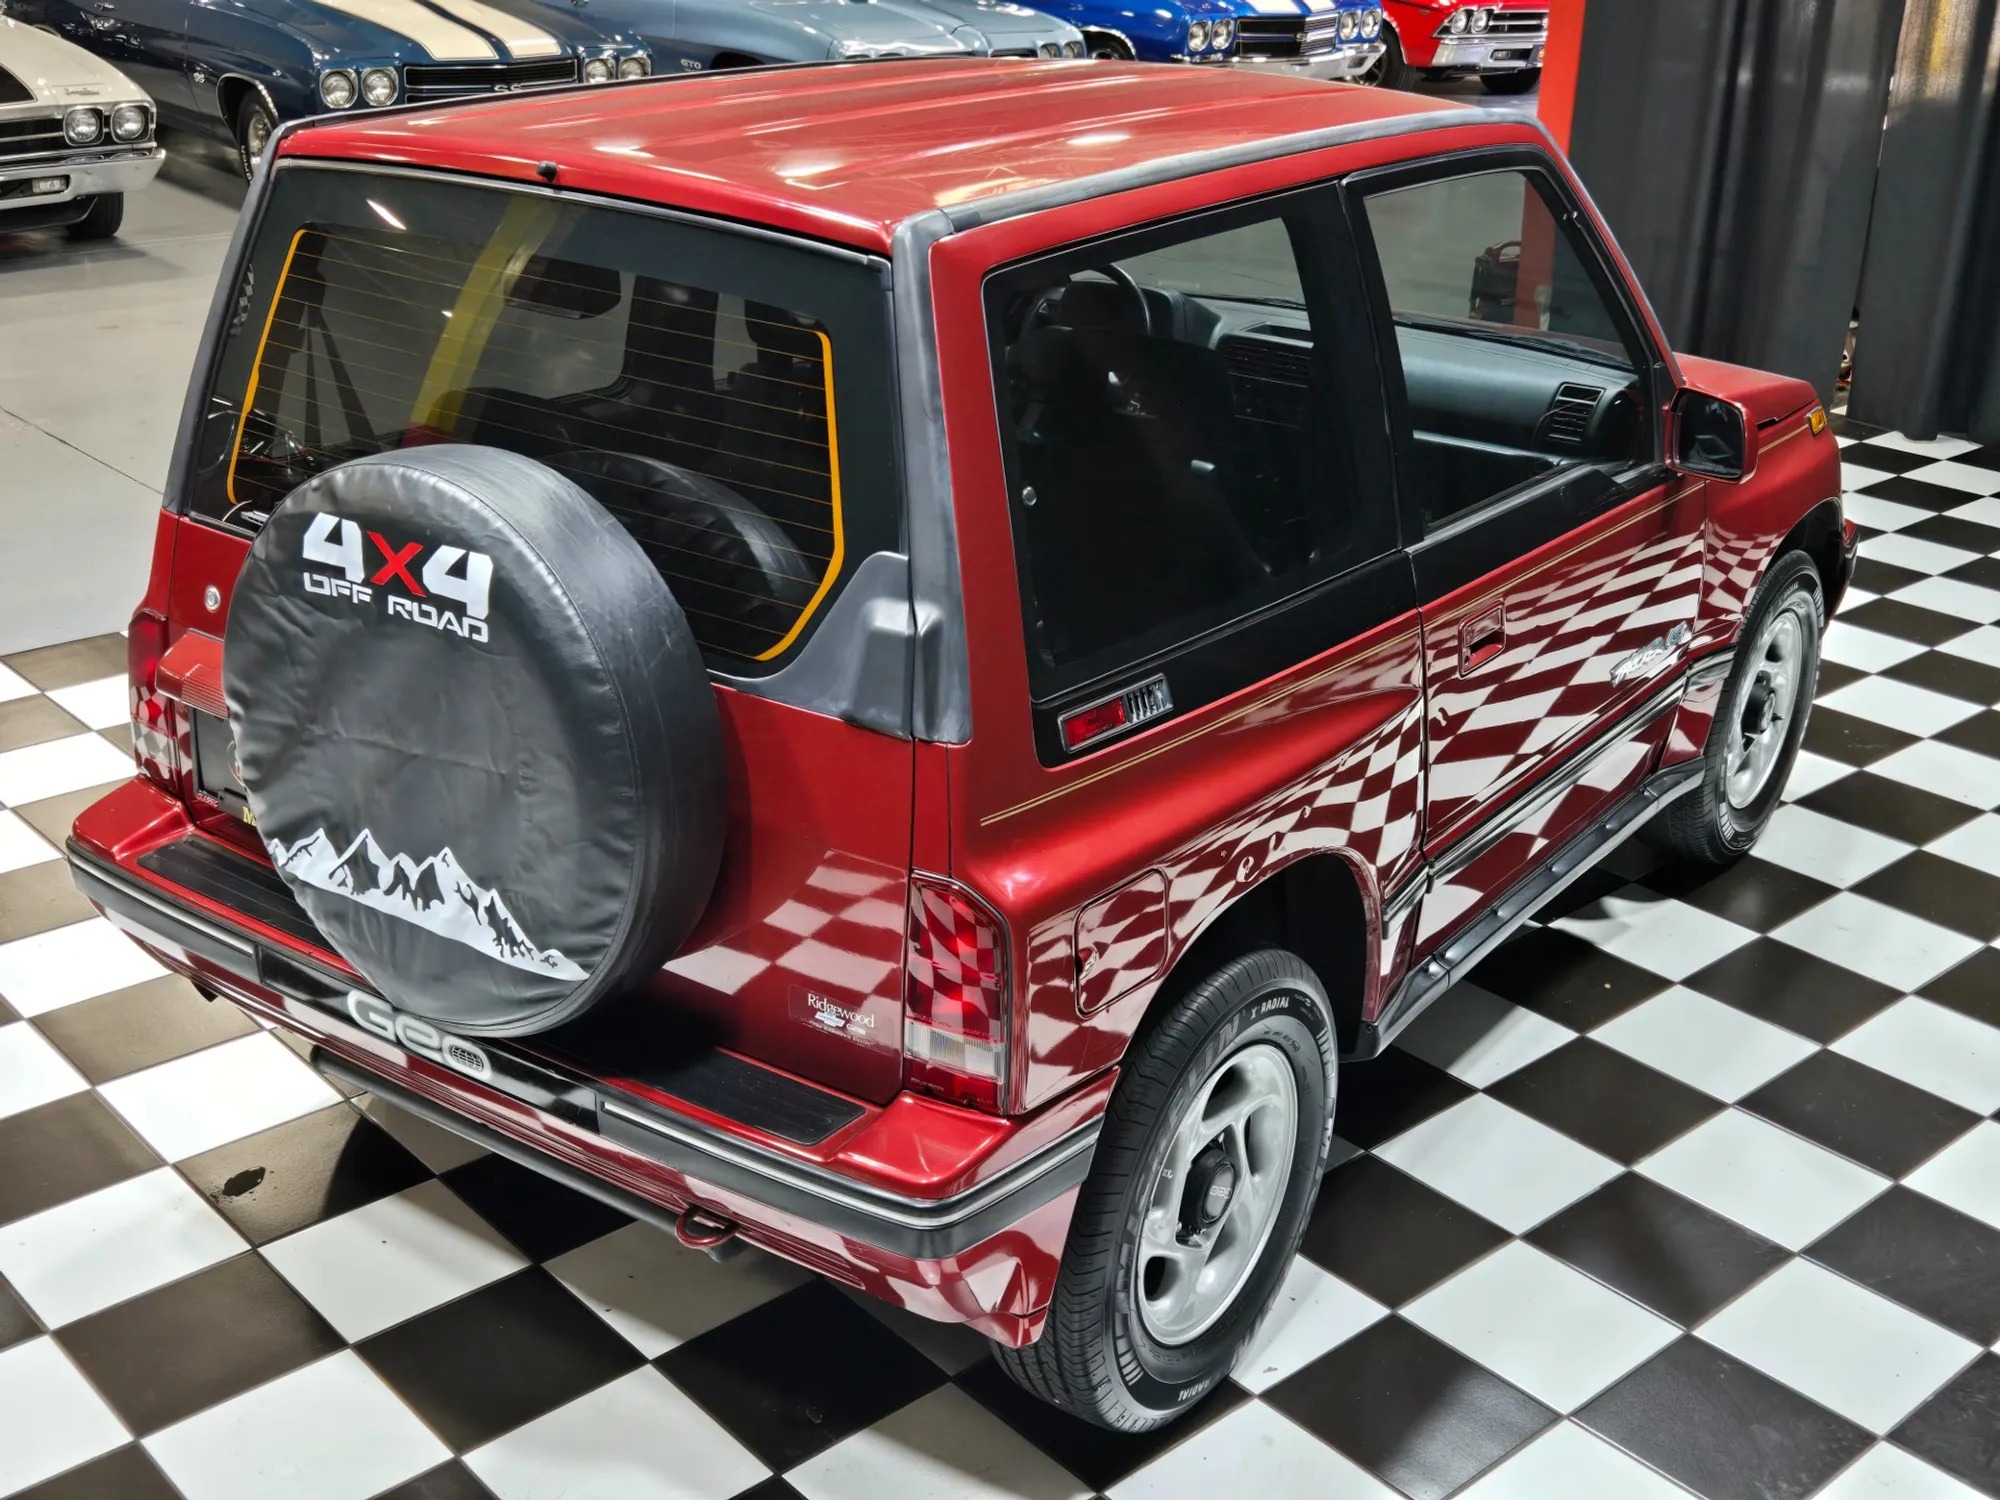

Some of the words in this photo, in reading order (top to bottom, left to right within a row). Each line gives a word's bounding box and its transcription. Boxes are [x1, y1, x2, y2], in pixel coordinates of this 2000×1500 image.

[681, 58, 702, 70] GTO
[303, 572, 372, 605] OFF
[387, 595, 488, 643] ROAD
[807, 992, 875, 1028] Ridgewood
[1260, 996, 1290, 1015] RADIAL
